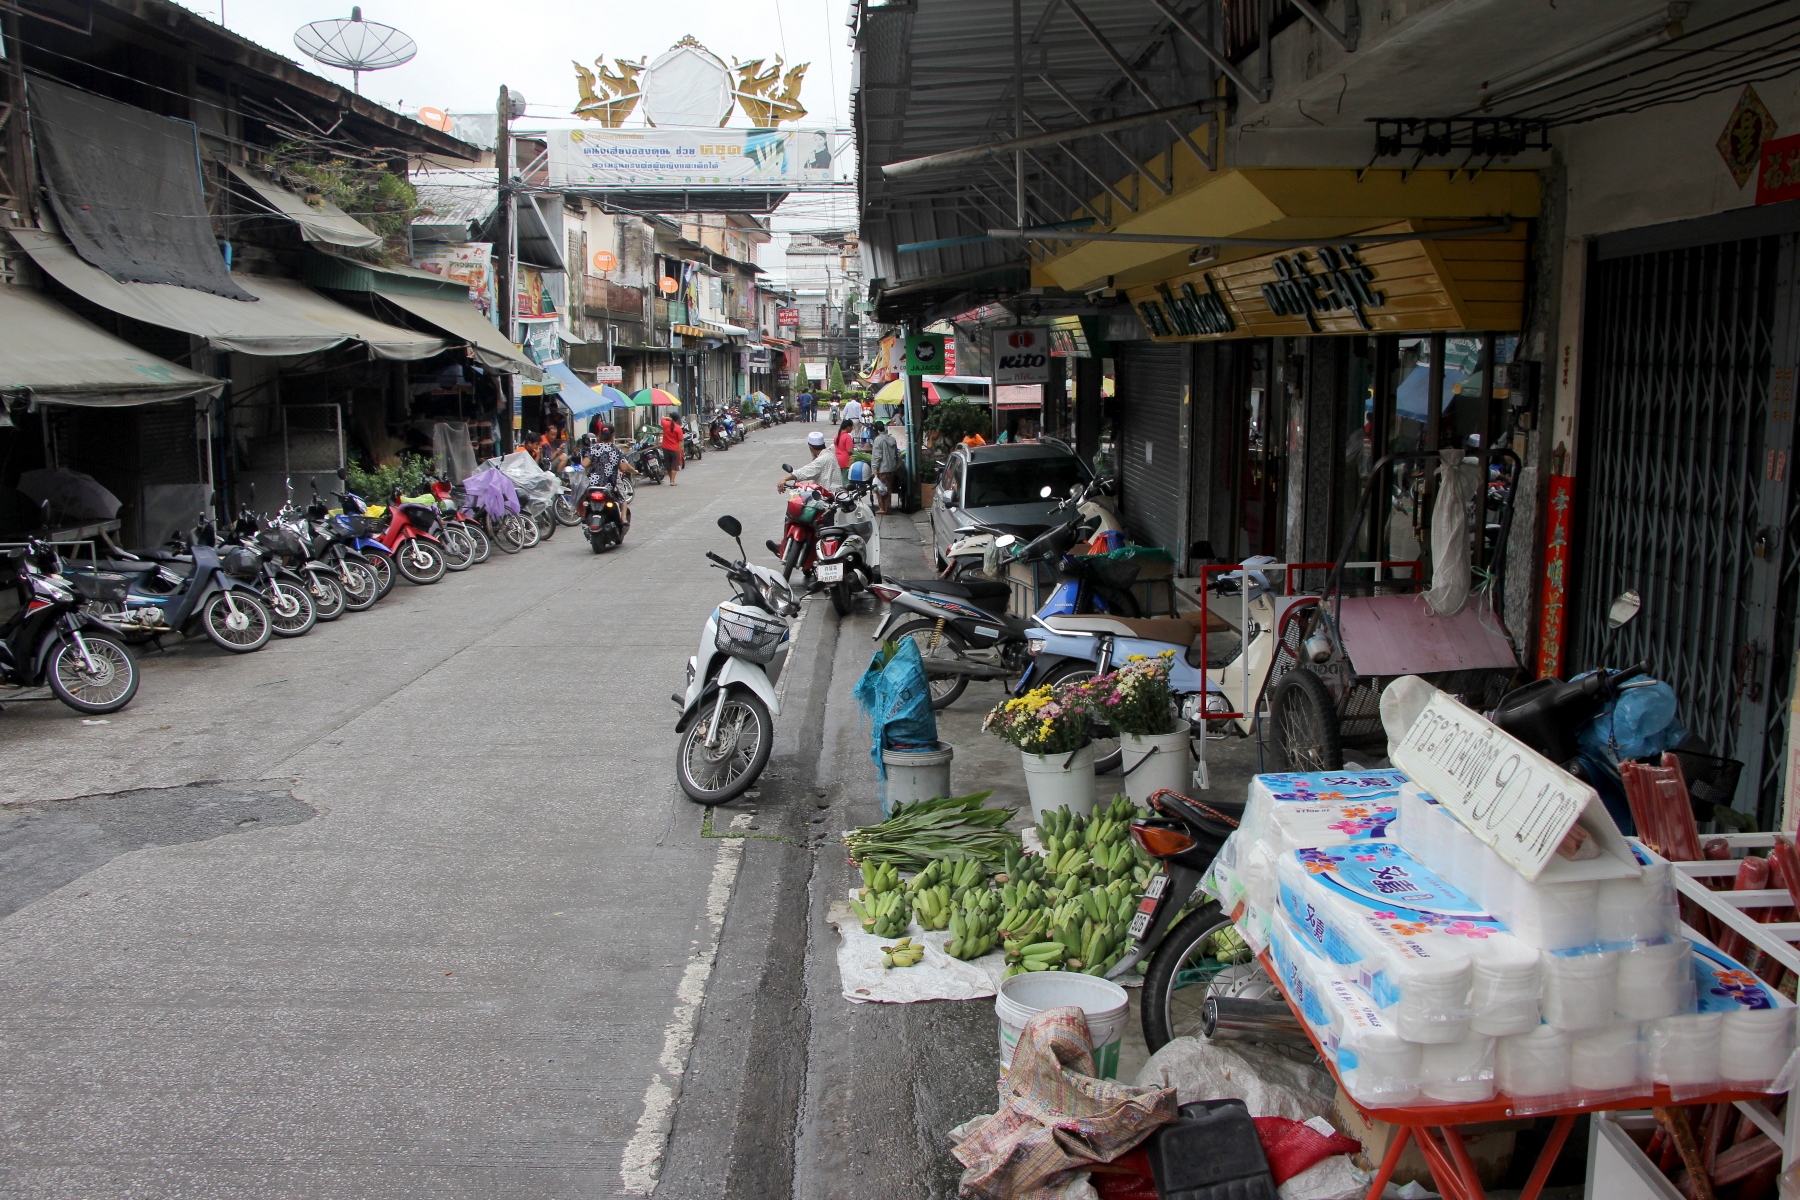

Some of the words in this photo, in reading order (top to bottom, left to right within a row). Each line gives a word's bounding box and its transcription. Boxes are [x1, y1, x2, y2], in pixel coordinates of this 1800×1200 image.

[910, 364, 941, 372] JAJACO
[998, 353, 1046, 369] Kito
[1472, 753, 1533, 830] 90
[1514, 783, 1579, 864] บาท
[1411, 945, 1431, 959] ROLLS
[1366, 1012, 1383, 1028] ROLLS
